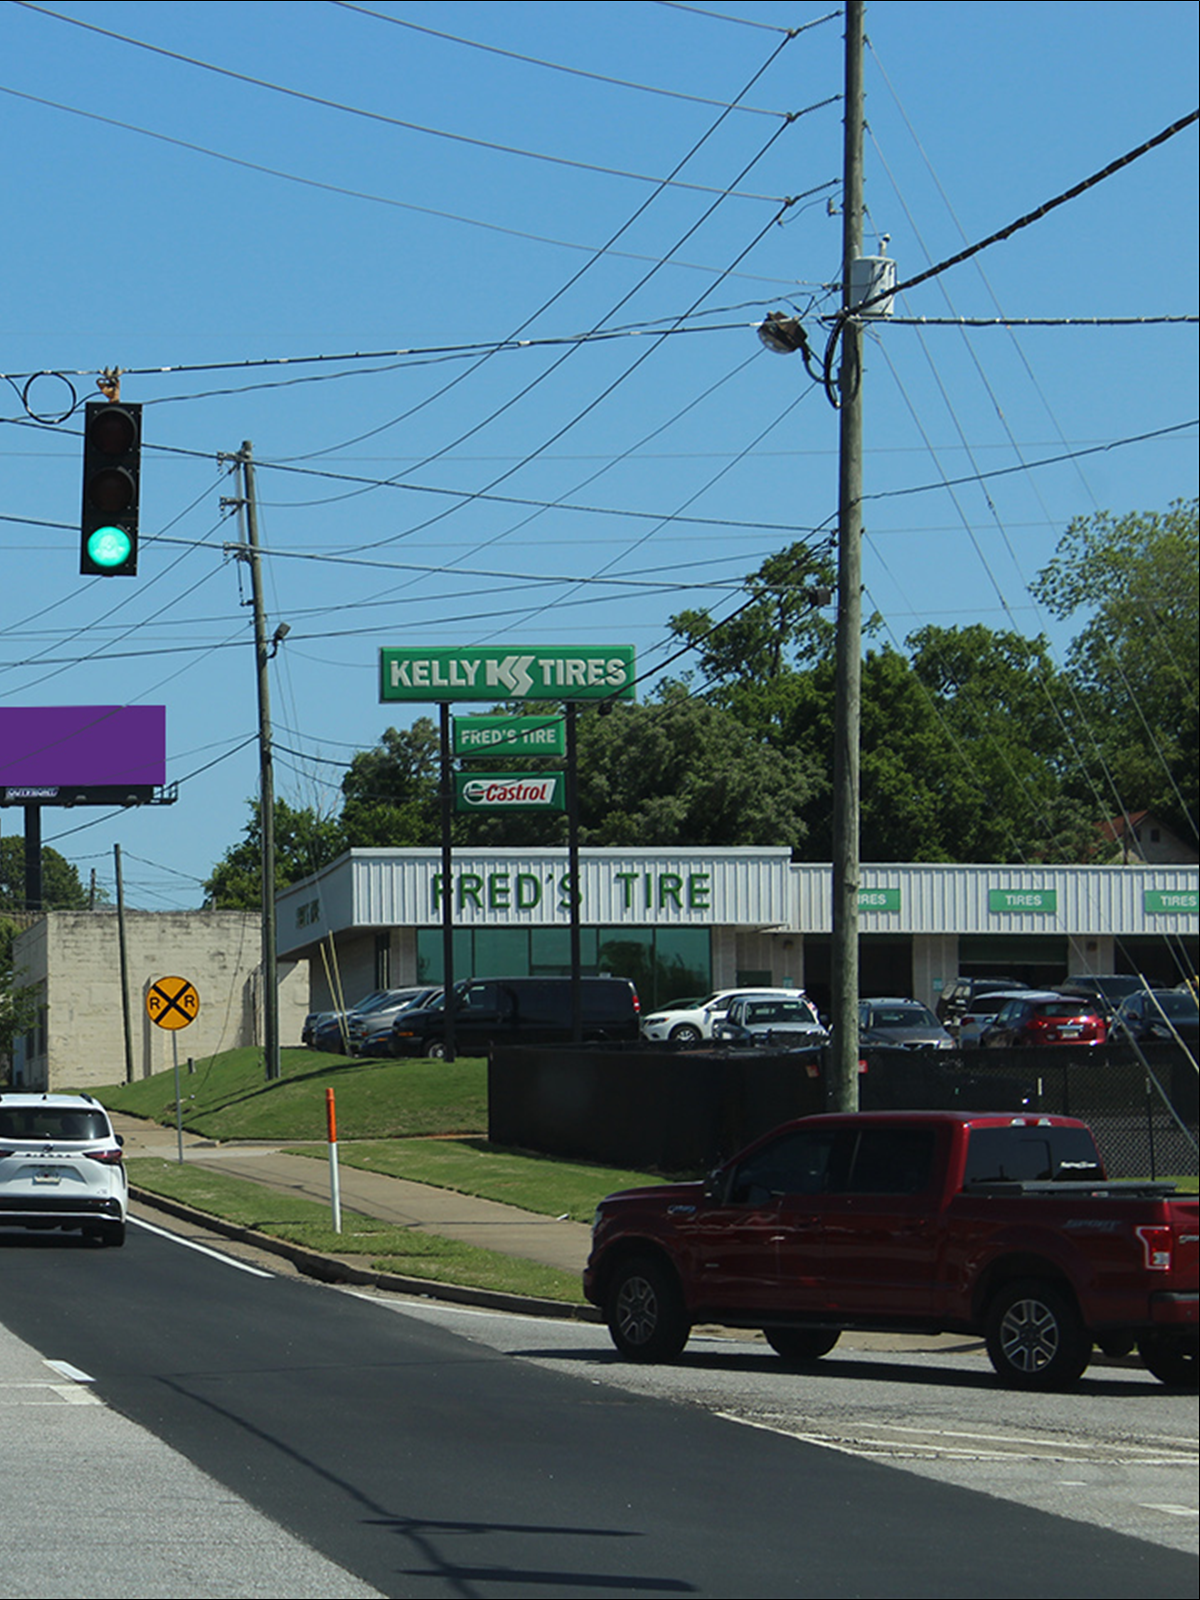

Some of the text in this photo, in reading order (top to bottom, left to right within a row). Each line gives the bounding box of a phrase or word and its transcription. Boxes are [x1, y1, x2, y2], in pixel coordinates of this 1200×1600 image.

[390, 659, 481, 687] KELLY
[538, 658, 627, 687] TIRES
[460, 728, 556, 745] FRED'S TIRE
[485, 783, 547, 802] Castrol
[432, 872, 711, 910] FRED'S TIRE
[857, 893, 887, 905] IRES
[1005, 894, 1042, 906] TIRES
[1160, 895, 1197, 907] TIRES
[150, 994, 196, 1010] R R
